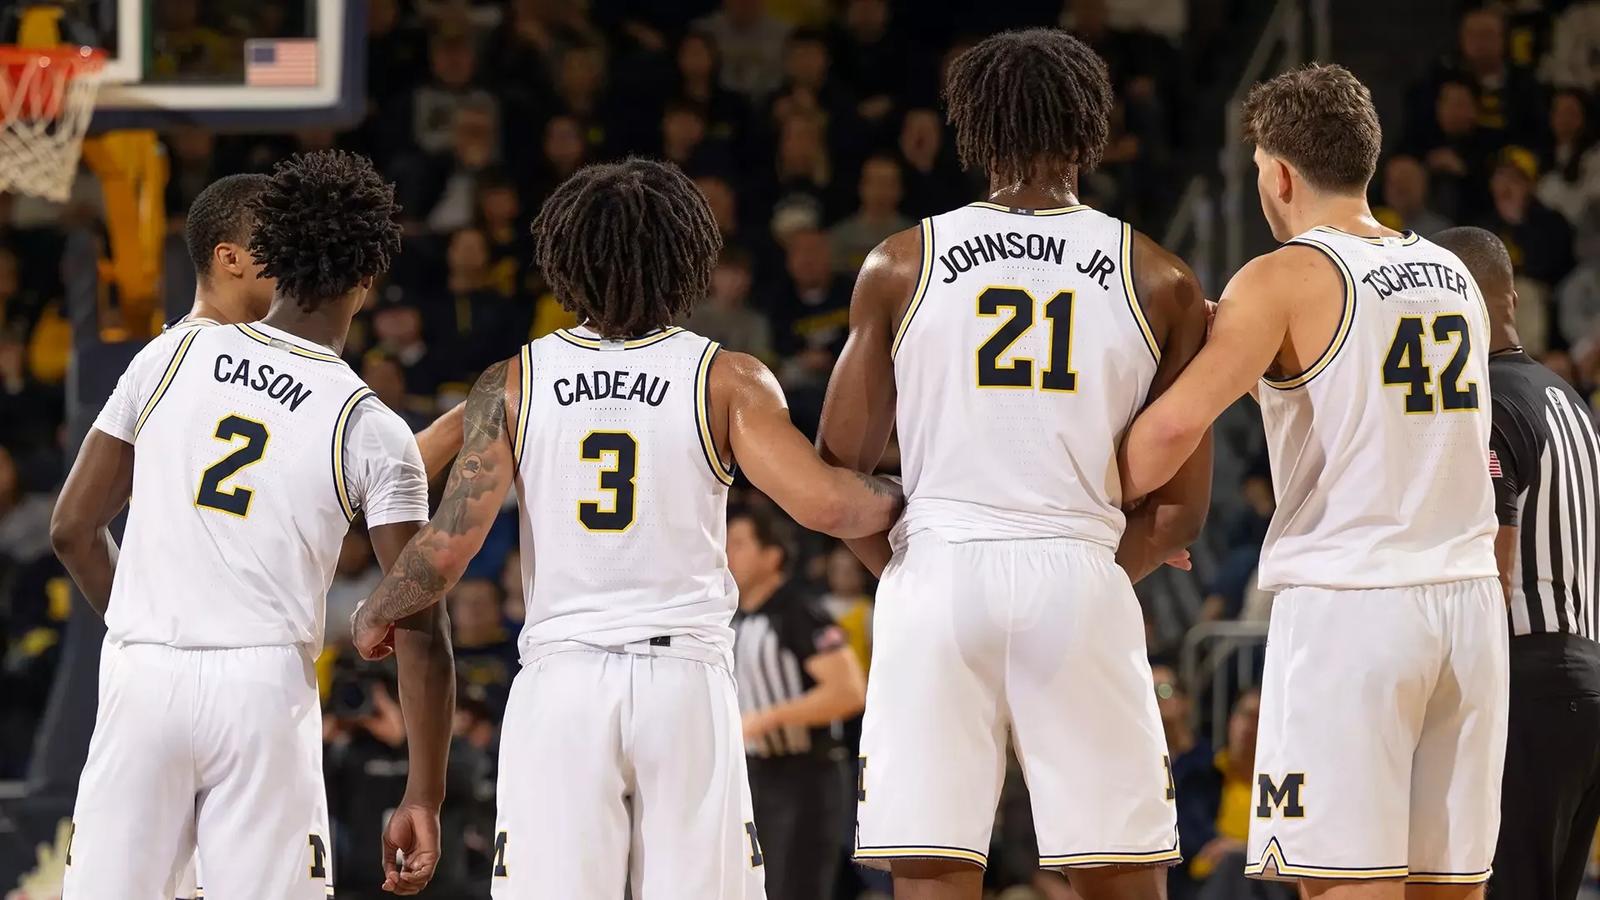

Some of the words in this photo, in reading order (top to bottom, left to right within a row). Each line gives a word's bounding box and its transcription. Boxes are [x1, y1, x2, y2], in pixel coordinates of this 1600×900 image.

[939, 232, 1066, 283] JOHNSON
[1076, 249, 1116, 291] JR.
[1362, 262, 1469, 301] TSCHETTER
[976, 285, 1079, 394] 21
[1382, 312, 1480, 415] 42
[213, 354, 313, 412] CASON
[553, 370, 671, 407] CADEAU
[194, 413, 271, 519] 2
[577, 430, 639, 533] 3
[1256, 772, 1305, 819] M
